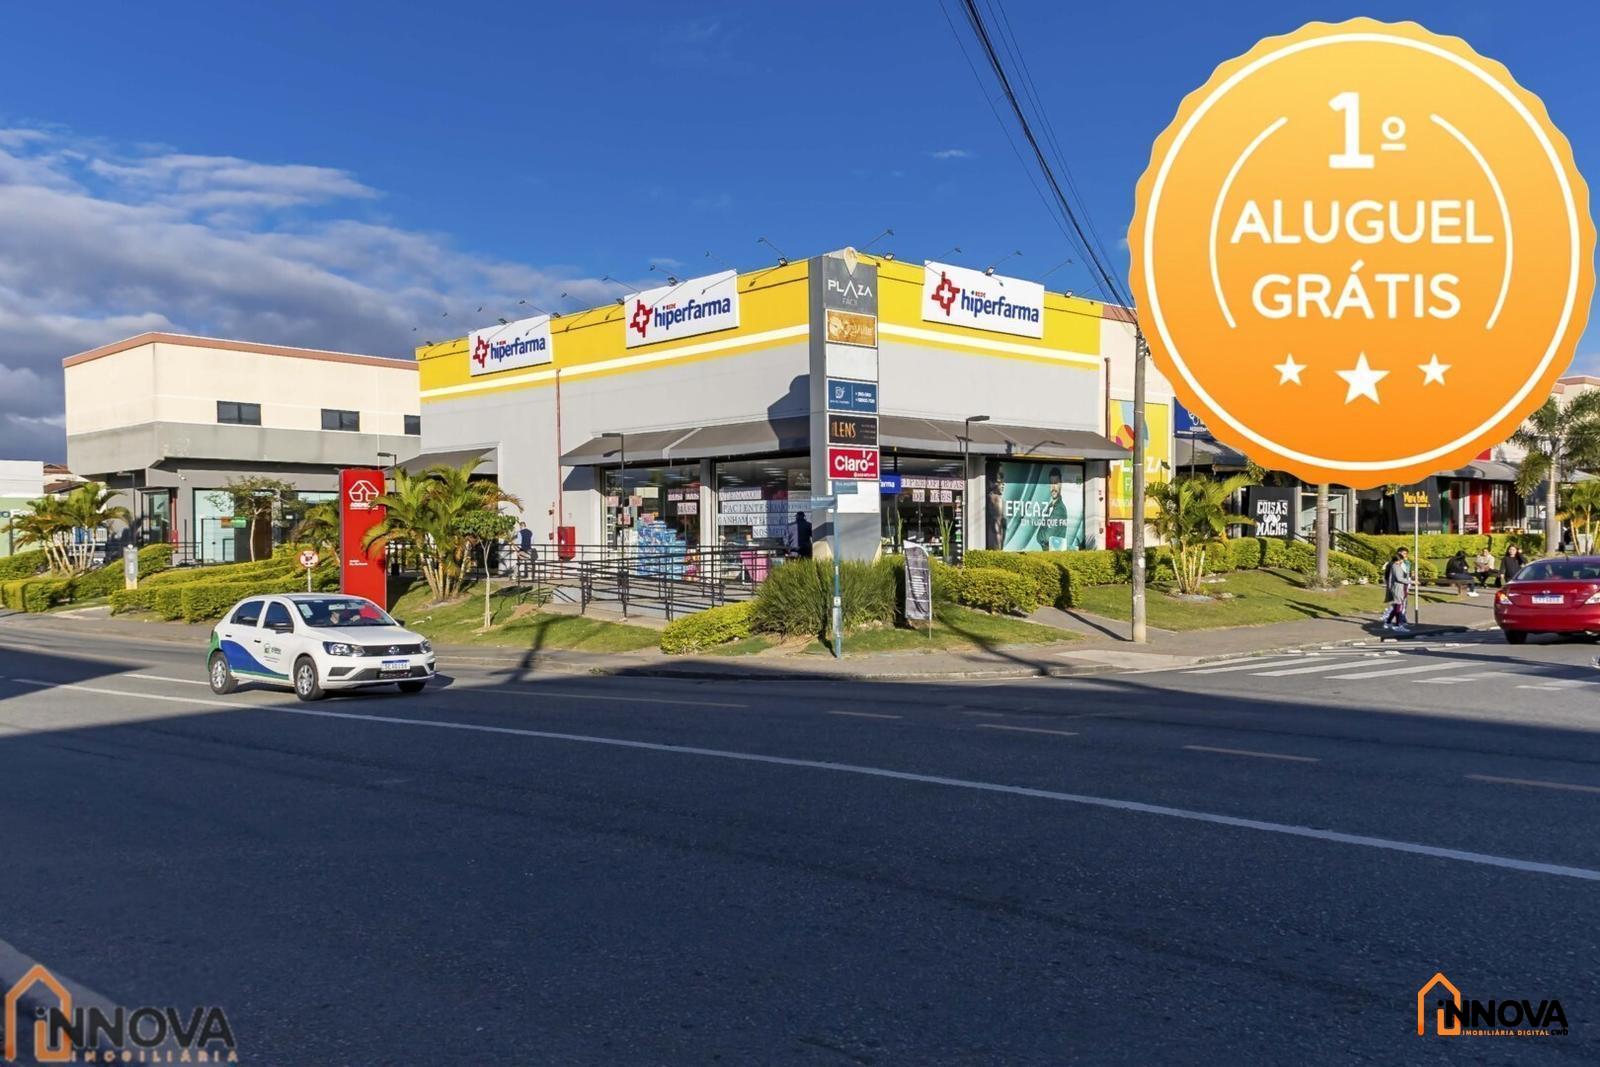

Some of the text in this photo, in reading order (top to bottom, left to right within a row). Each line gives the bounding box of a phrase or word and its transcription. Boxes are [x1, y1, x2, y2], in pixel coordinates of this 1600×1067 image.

[828, 280, 872, 298] PLAZA
[654, 298, 731, 330] hiperfarma
[961, 288, 1040, 323] hiperfarma
[490, 337, 546, 362] hiperfarma
[834, 420, 857, 439] LENS
[834, 454, 869, 472] Claro
[1257, 501, 1288, 515] COISAS
